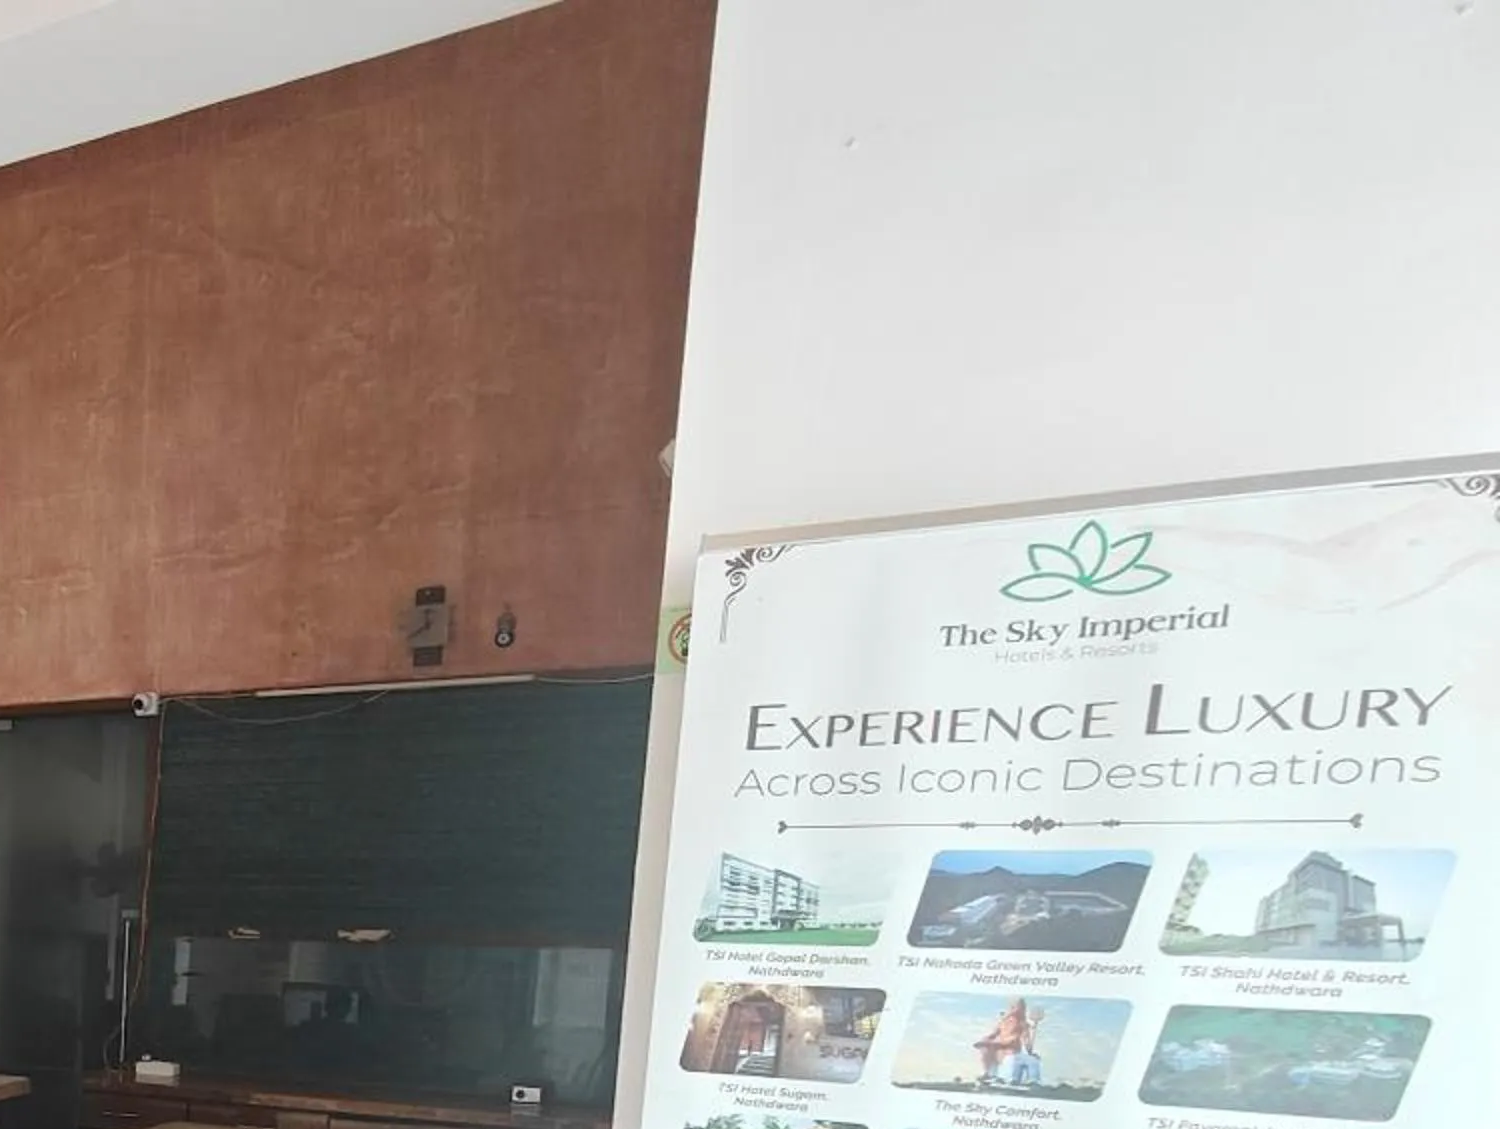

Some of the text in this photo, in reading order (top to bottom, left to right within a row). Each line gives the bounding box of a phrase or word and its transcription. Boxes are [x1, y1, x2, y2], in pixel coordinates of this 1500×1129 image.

[940, 603, 1229, 647] The Sky Imperial
[994, 642, 1158, 665] Hotels & Resorts
[746, 683, 1453, 750] EXPERIENCE LUXURY
[734, 750, 1442, 797] Across Iconic Destinations
[706, 950, 725, 962] TSI
[728, 951, 762, 963] Hotel
[765, 952, 807, 964] Gopal
[748, 965, 824, 978] Nathdwara
[898, 956, 920, 967] TSI
[986, 959, 1031, 972] Green
[1035, 961, 1085, 976] Valley
[1179, 965, 1207, 977] TSI
[1209, 966, 1264, 979] Shahi
[1267, 968, 1318, 982] Hotel
[1321, 970, 1335, 982] &
[970, 973, 1059, 987] Nathdwara
[1235, 982, 1342, 998] Nathdwara
[719, 1082, 739, 1093] TSI
[741, 1085, 776, 1096] Hotel
[733, 1097, 808, 1112] Nathdwara
[935, 1099, 961, 1112] The
[964, 1102, 992, 1116] Sky
[1147, 1117, 1175, 1129] TSI
